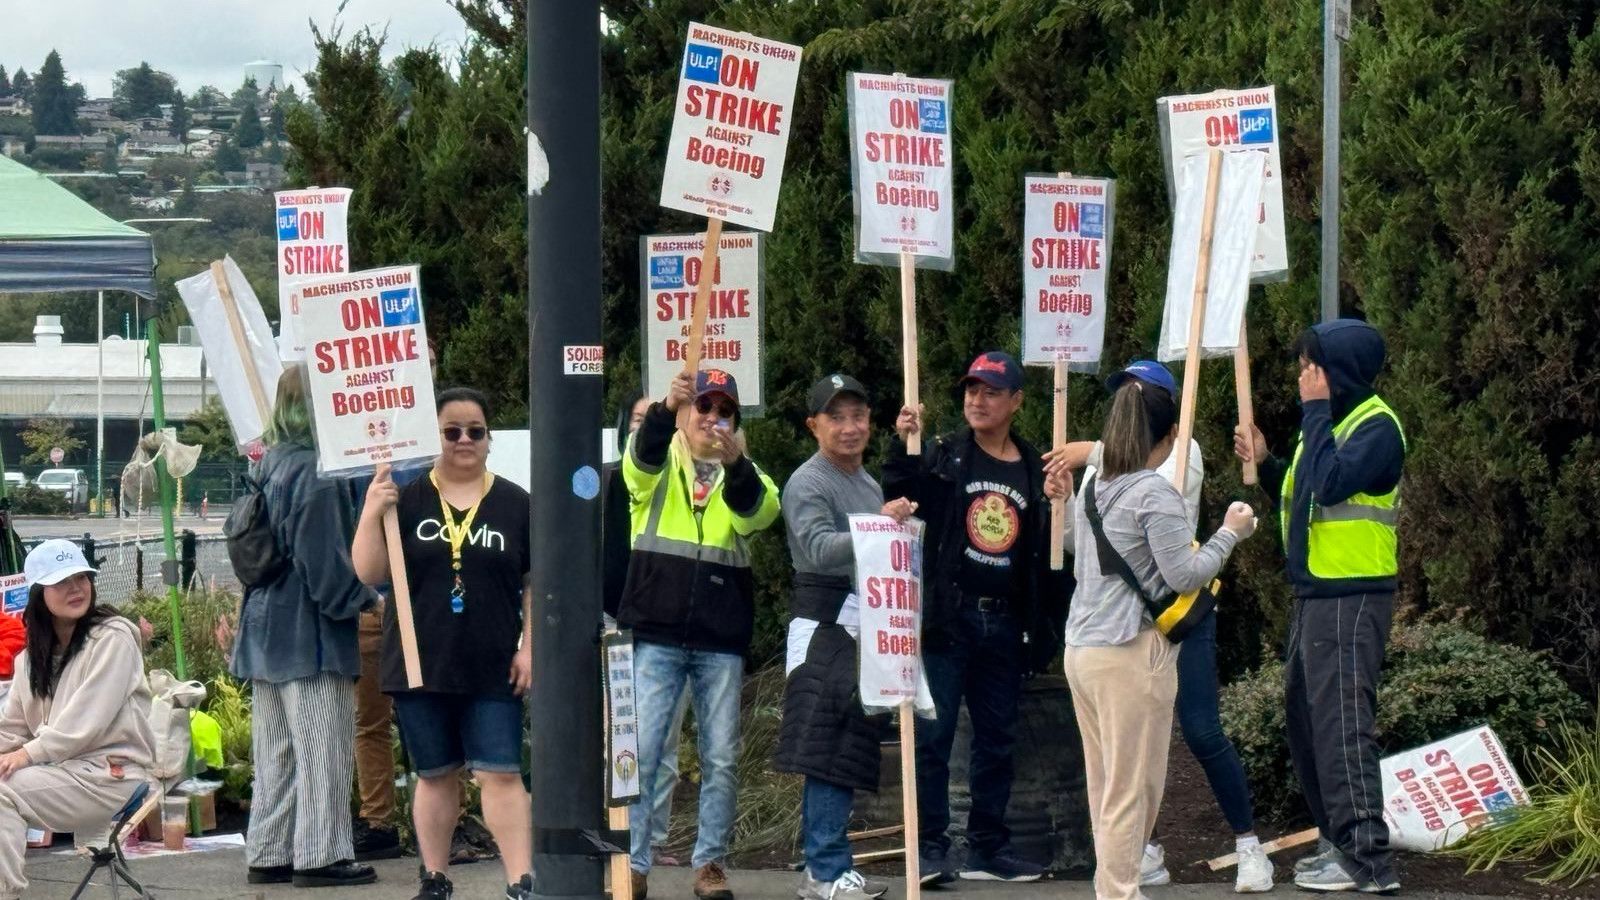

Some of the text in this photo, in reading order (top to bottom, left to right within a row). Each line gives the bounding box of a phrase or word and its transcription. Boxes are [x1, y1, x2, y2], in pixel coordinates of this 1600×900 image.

[692, 28, 796, 62] MACHINISTS UNION
[720, 54, 760, 93] ON
[859, 78, 945, 97] MACHINISTS UNION
[684, 84, 784, 136] STRIKE
[889, 98, 920, 130] ON
[1172, 92, 1270, 113] MACHINISTS UNION
[705, 125, 754, 147] AGAINST
[1204, 114, 1240, 147] ON
[685, 136, 766, 180] Boeing
[865, 131, 945, 167] STRIKE
[888, 168, 925, 184] AGAINST
[875, 181, 940, 212] Boeing
[300, 210, 325, 241] ON
[1054, 201, 1080, 233] ON
[284, 244, 345, 276] STRIKE
[720, 238, 753, 250] UNION
[1031, 237, 1101, 270] STRIKE
[302, 272, 412, 299] MACHINISTS UNION
[1049, 274, 1081, 288] AGAINST
[340, 295, 382, 332] ON
[1038, 289, 1093, 317] Boeing
[314, 328, 420, 375] STRIKE
[345, 368, 395, 389] AGAINST
[331, 385, 416, 417] Boeing
[416, 518, 505, 552] Cavin
[1478, 731, 1516, 787] MACHINISTS
[1421, 776, 1451, 812] AGAINST
[1467, 763, 1504, 798] ON
[1395, 768, 1446, 832] Boeing
